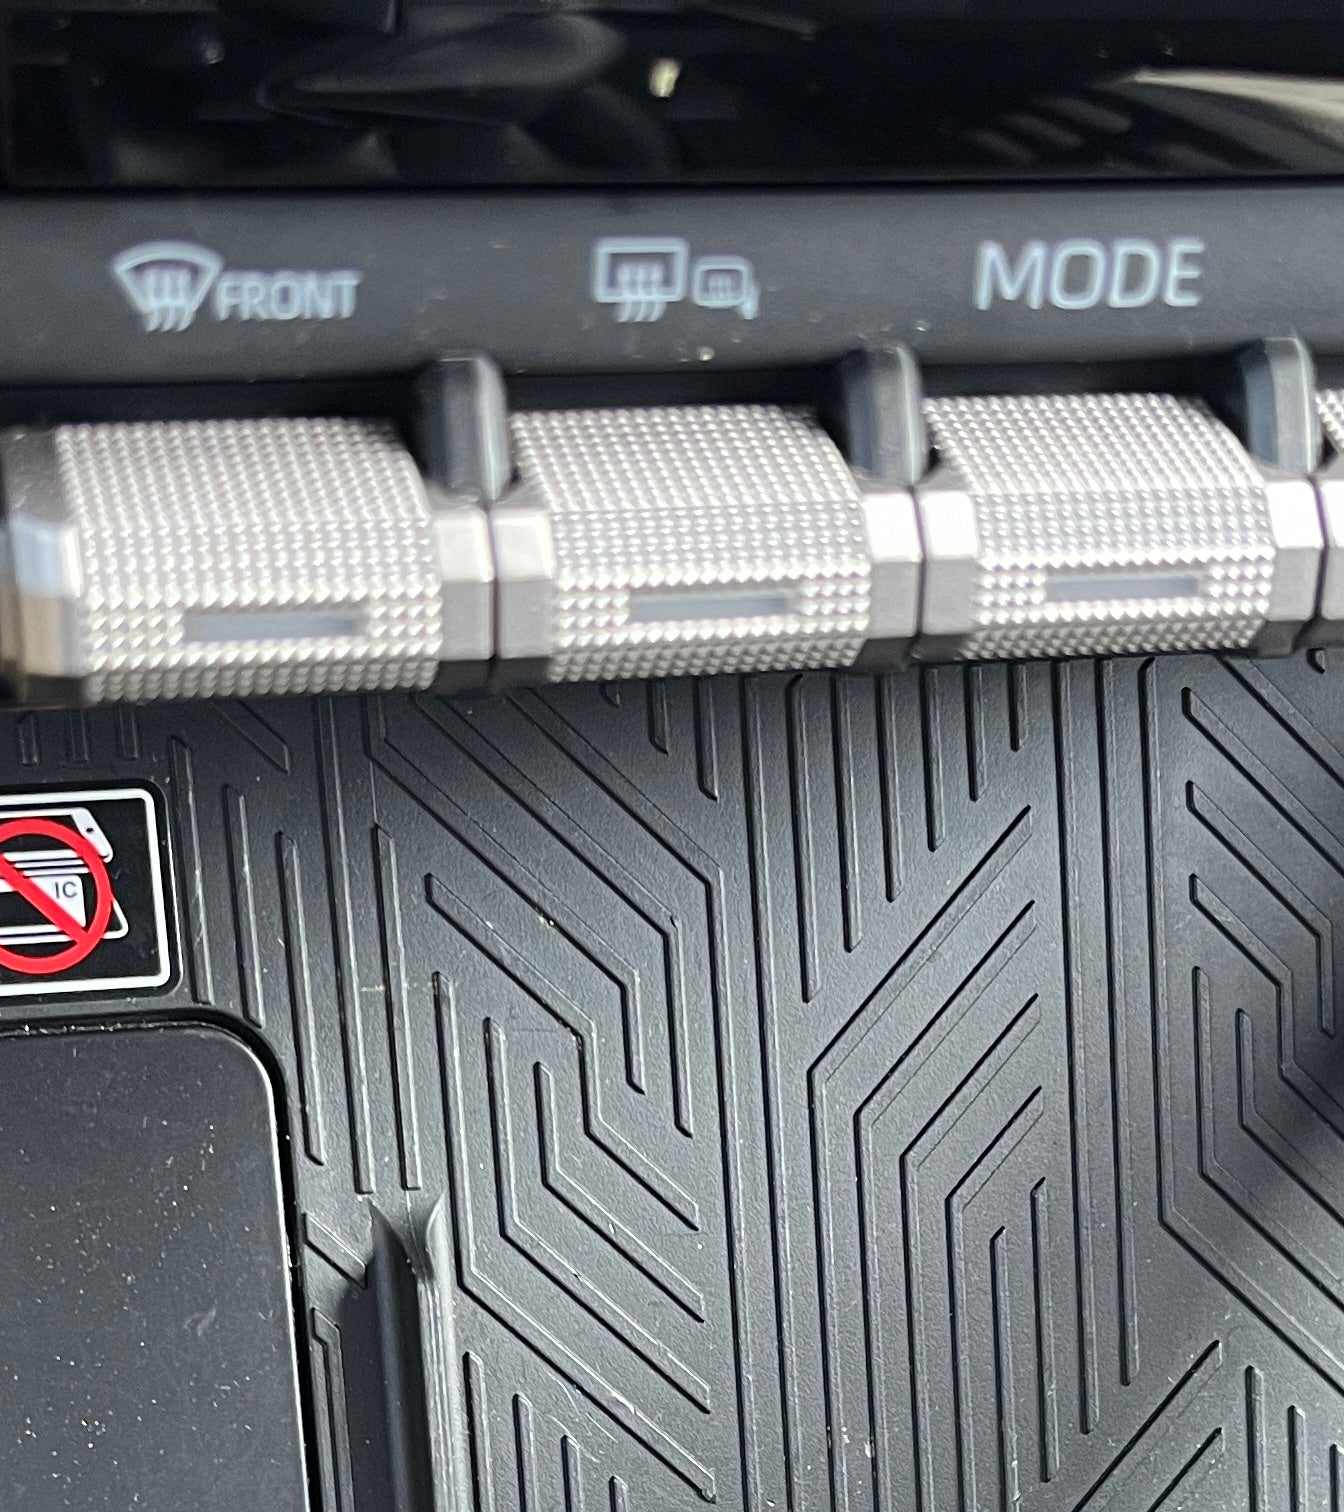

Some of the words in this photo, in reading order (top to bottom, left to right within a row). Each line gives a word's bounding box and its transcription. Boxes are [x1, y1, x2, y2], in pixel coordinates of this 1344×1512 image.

[216, 270, 360, 321] FRONT
[974, 237, 1206, 311] MODE
[54, 880, 78, 899] IC
